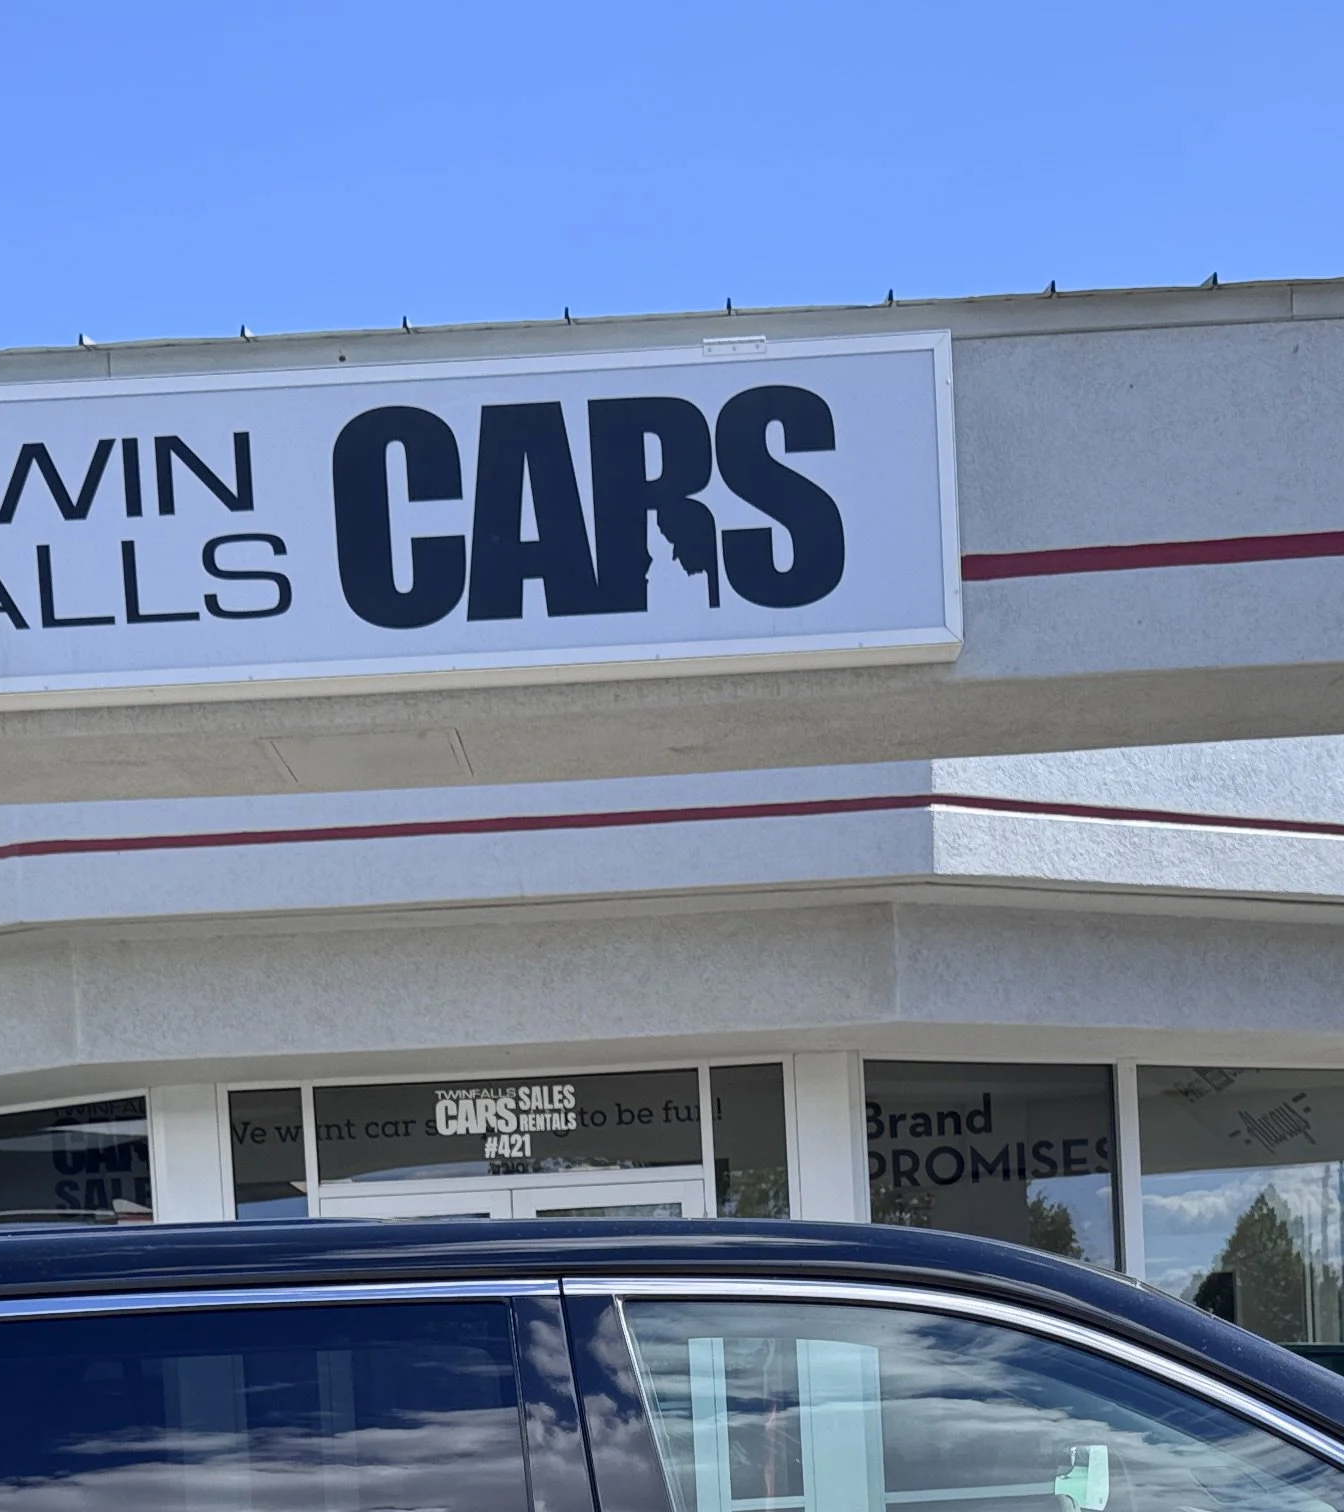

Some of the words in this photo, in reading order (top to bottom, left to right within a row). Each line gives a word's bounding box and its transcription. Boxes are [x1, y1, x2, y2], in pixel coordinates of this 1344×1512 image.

[332, 385, 845, 629] CARS
[518, 1084, 575, 1111] SALES
[436, 1097, 517, 1136] CARS
[519, 1111, 577, 1132] RENTALS
[578, 1107, 607, 1128] to
[614, 1102, 653, 1126] be
[662, 1097, 723, 1123] fu!
[866, 1092, 992, 1139] Brand
[274, 1119, 356, 1143] wnt
[365, 1119, 416, 1139] car
[484, 1134, 532, 1159] #421
